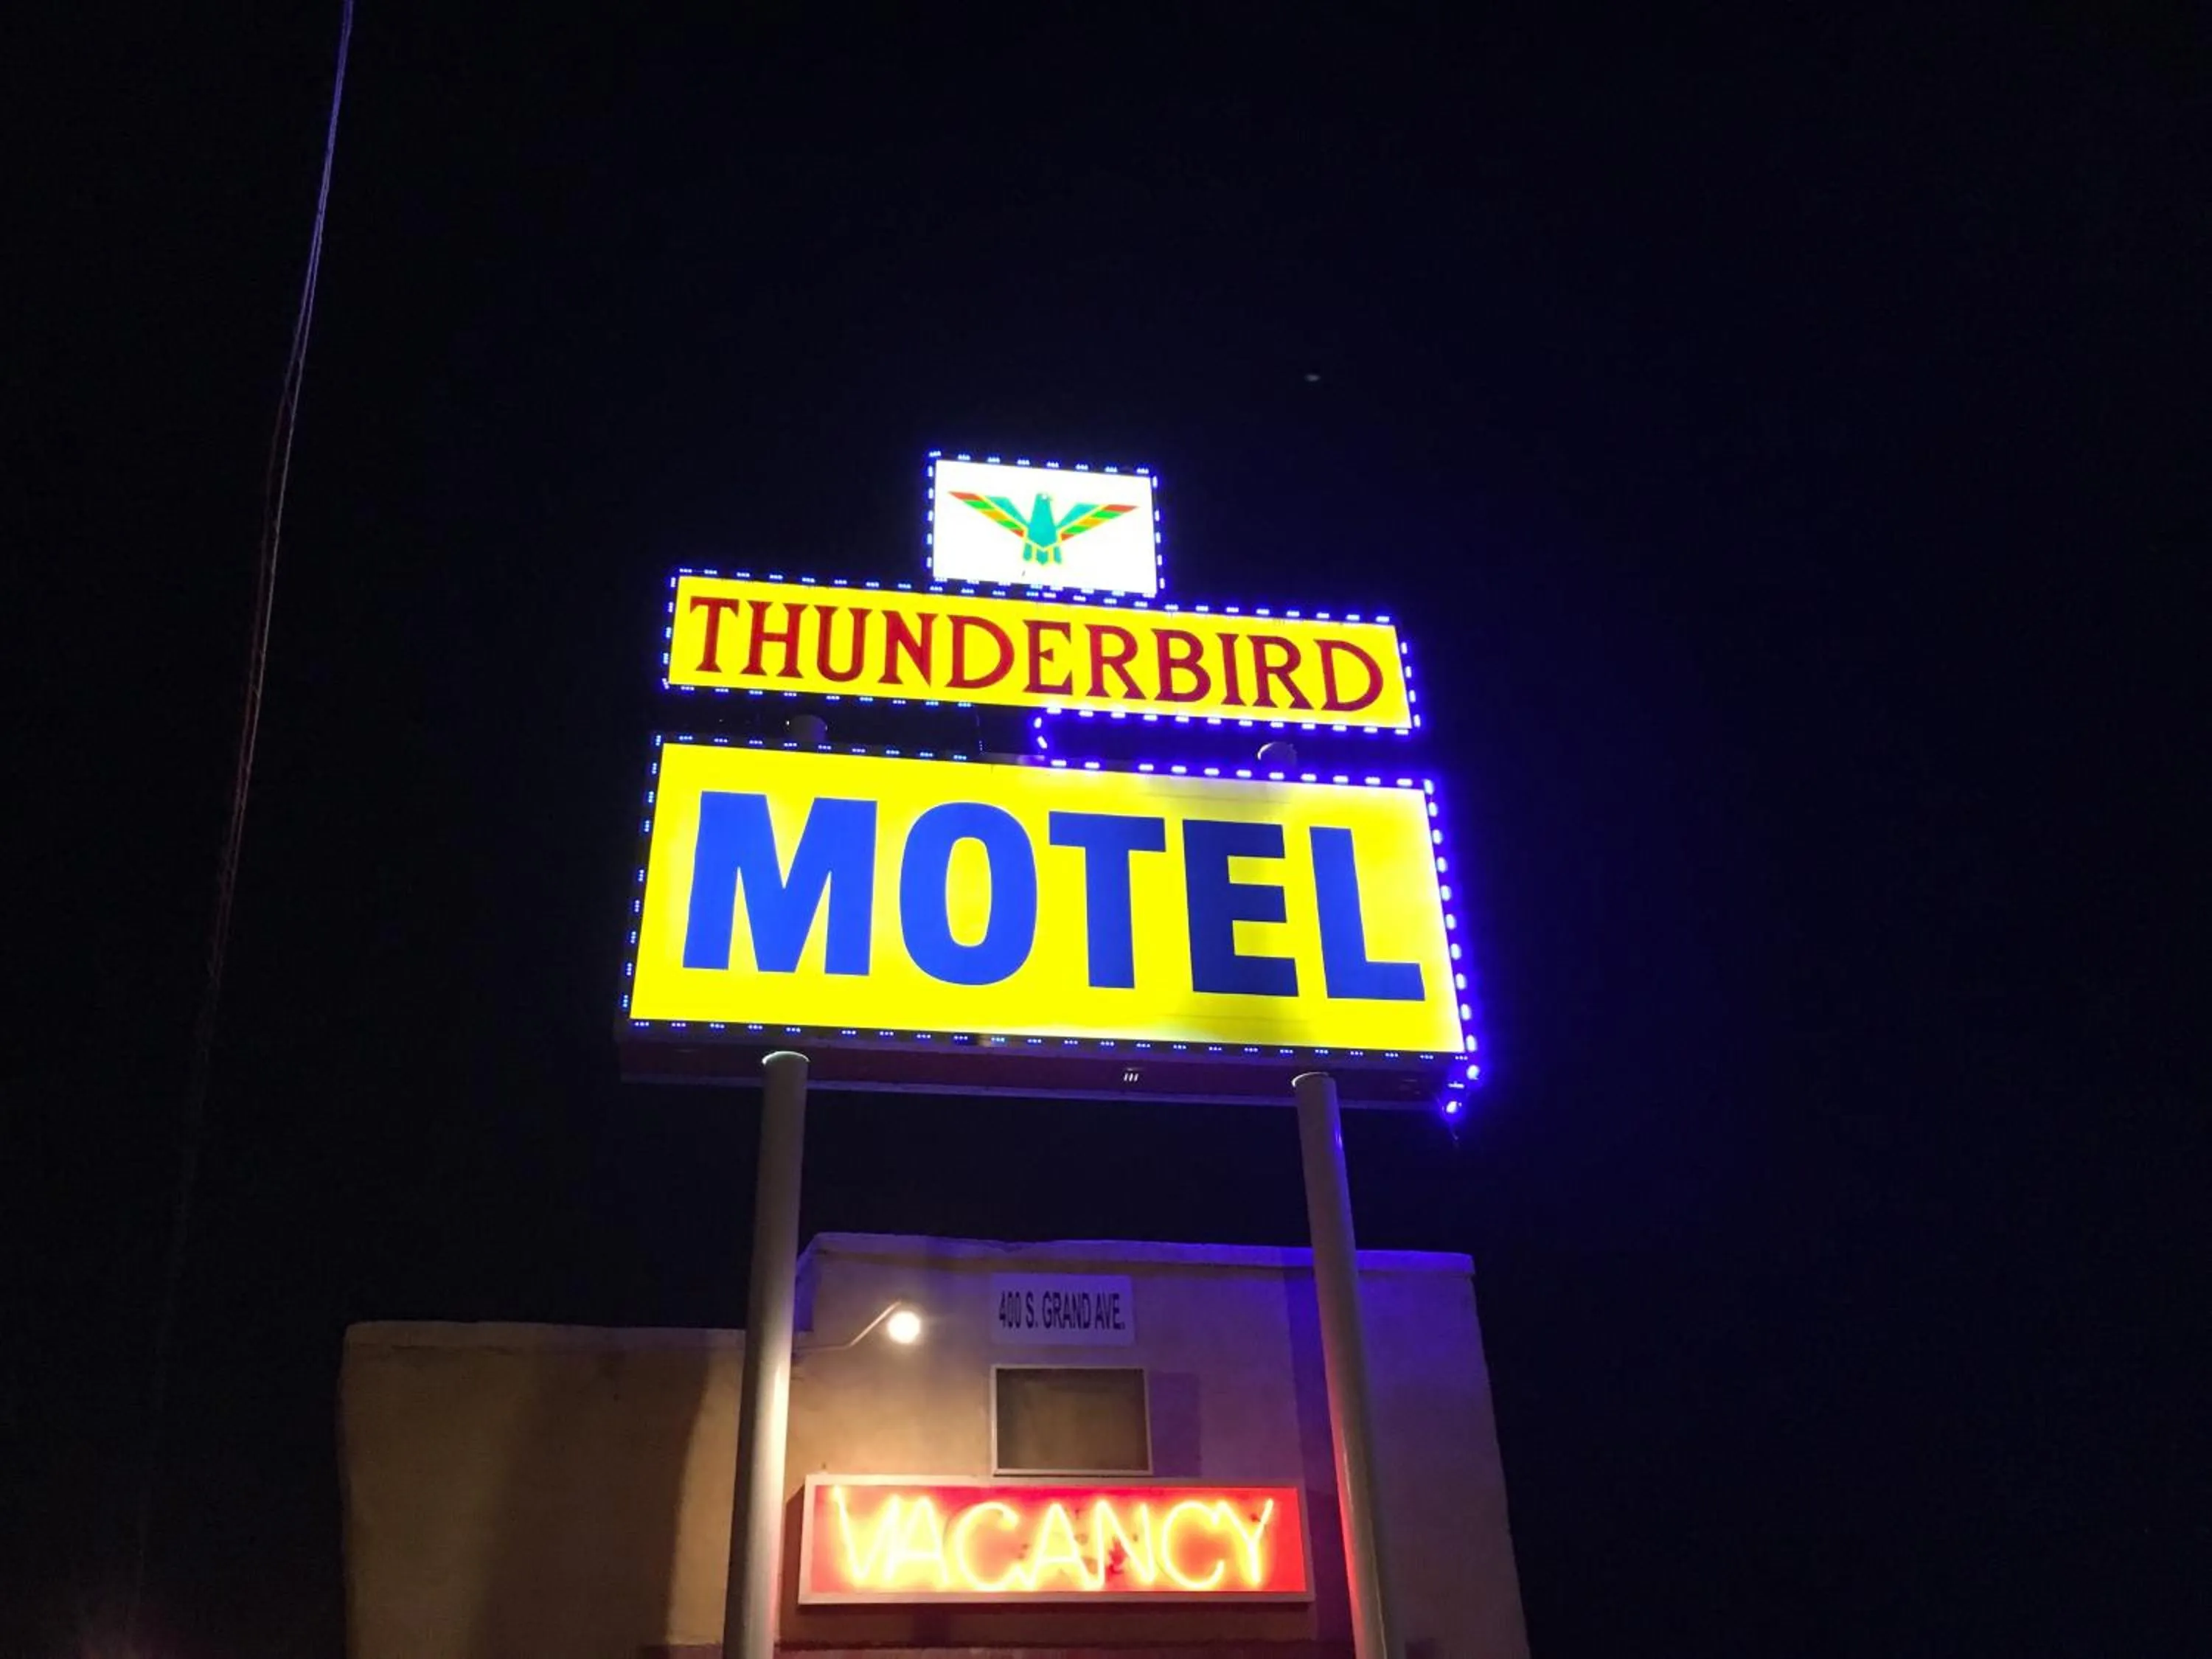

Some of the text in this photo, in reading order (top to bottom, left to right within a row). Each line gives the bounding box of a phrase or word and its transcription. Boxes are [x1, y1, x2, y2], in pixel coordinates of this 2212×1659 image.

[689, 596, 1383, 712] THUNDERBIRD
[682, 790, 1425, 1001] MOTEL
[999, 1290, 1126, 1330] 400 S. GRAND AVE.
[832, 1485, 1275, 1591] VACANCY
